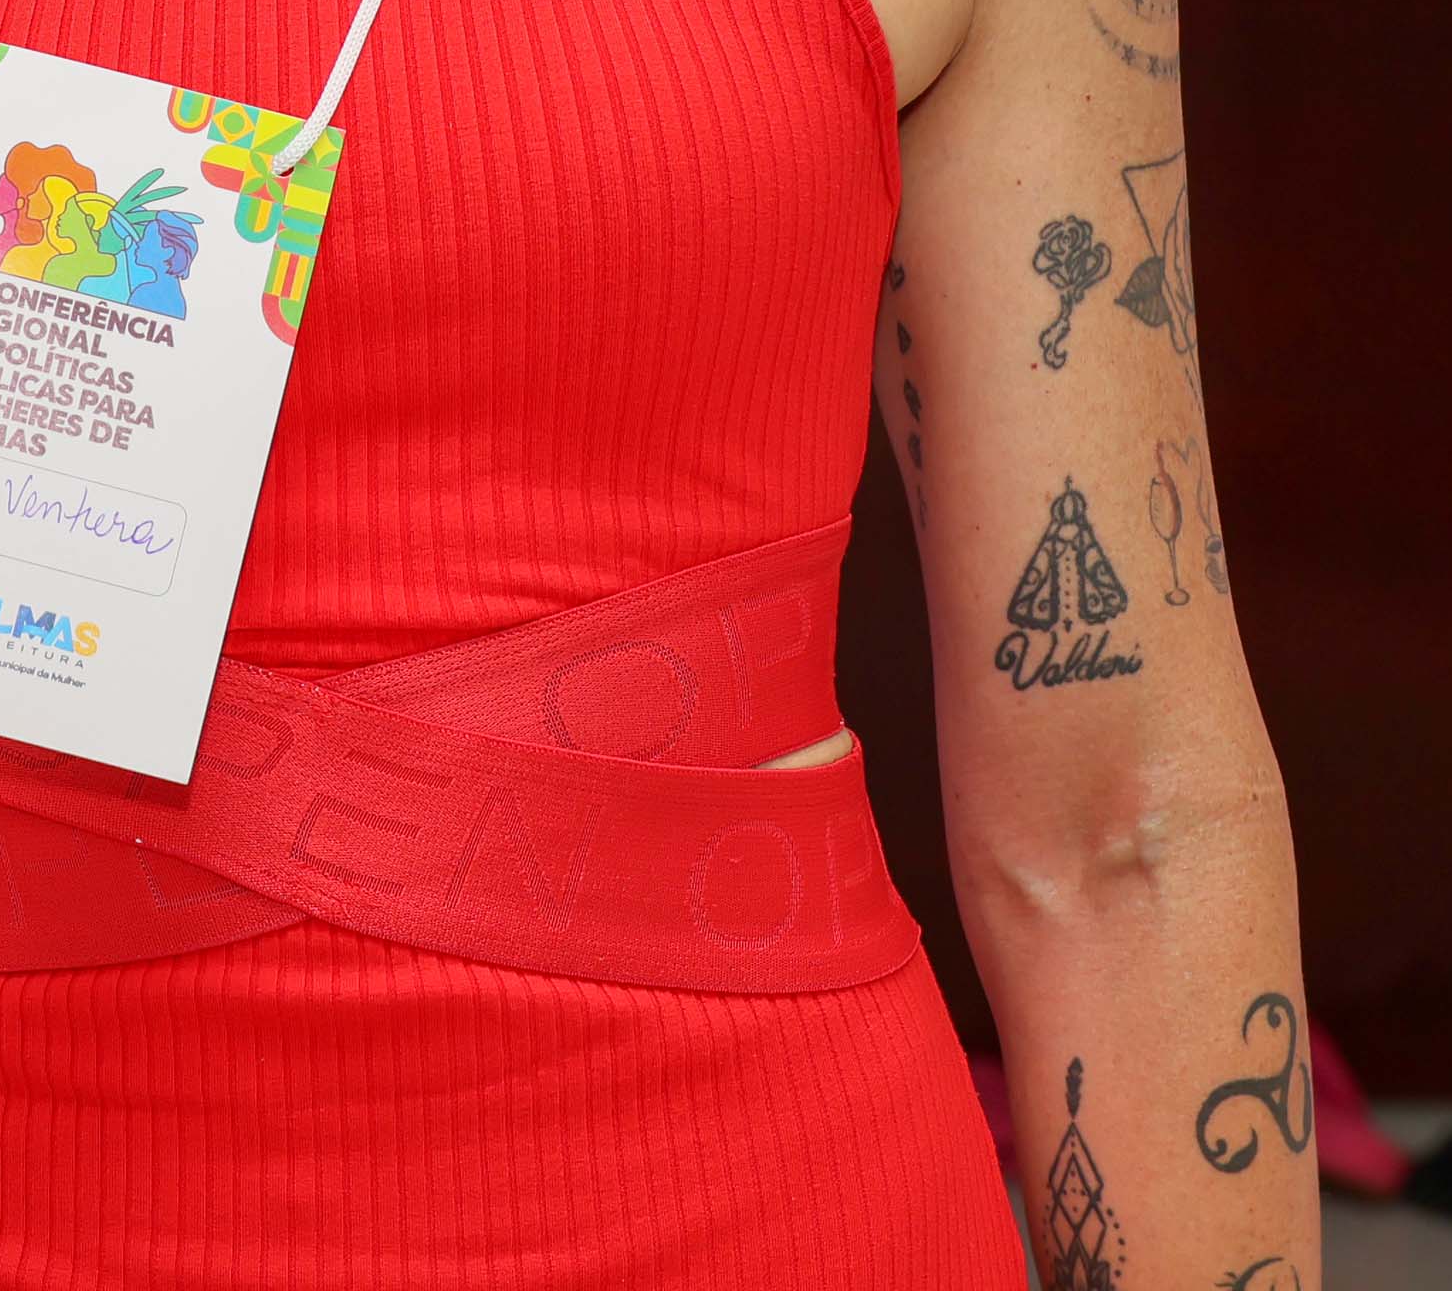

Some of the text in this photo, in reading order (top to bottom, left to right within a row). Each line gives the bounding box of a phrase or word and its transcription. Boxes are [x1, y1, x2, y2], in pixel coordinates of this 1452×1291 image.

[78, 389, 156, 429] PARA
[89, 419, 133, 450] DE
[36, 667, 49, 680] da
[50, 672, 86, 689] Mulher
